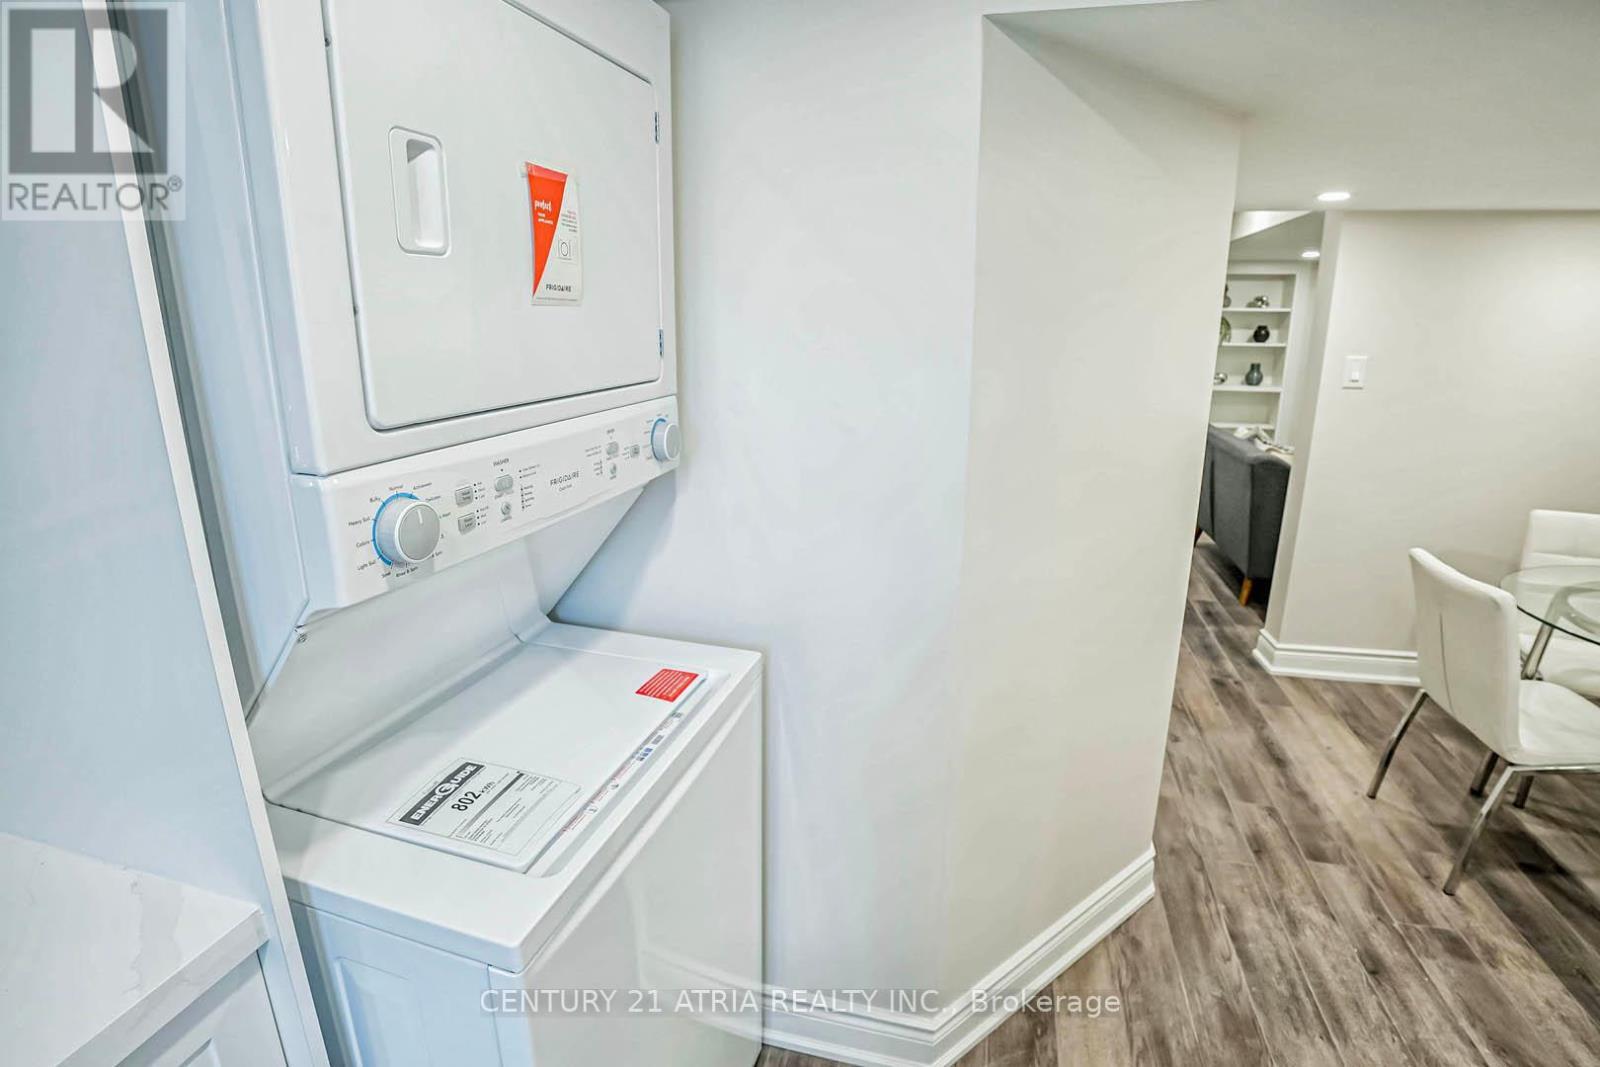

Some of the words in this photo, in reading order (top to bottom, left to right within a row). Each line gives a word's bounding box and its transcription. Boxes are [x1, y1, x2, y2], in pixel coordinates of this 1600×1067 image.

[545, 283, 572, 293] FRIGIDAIRE
[550, 470, 580, 486] FRIGIDAIRE
[451, 790, 482, 812] 802
